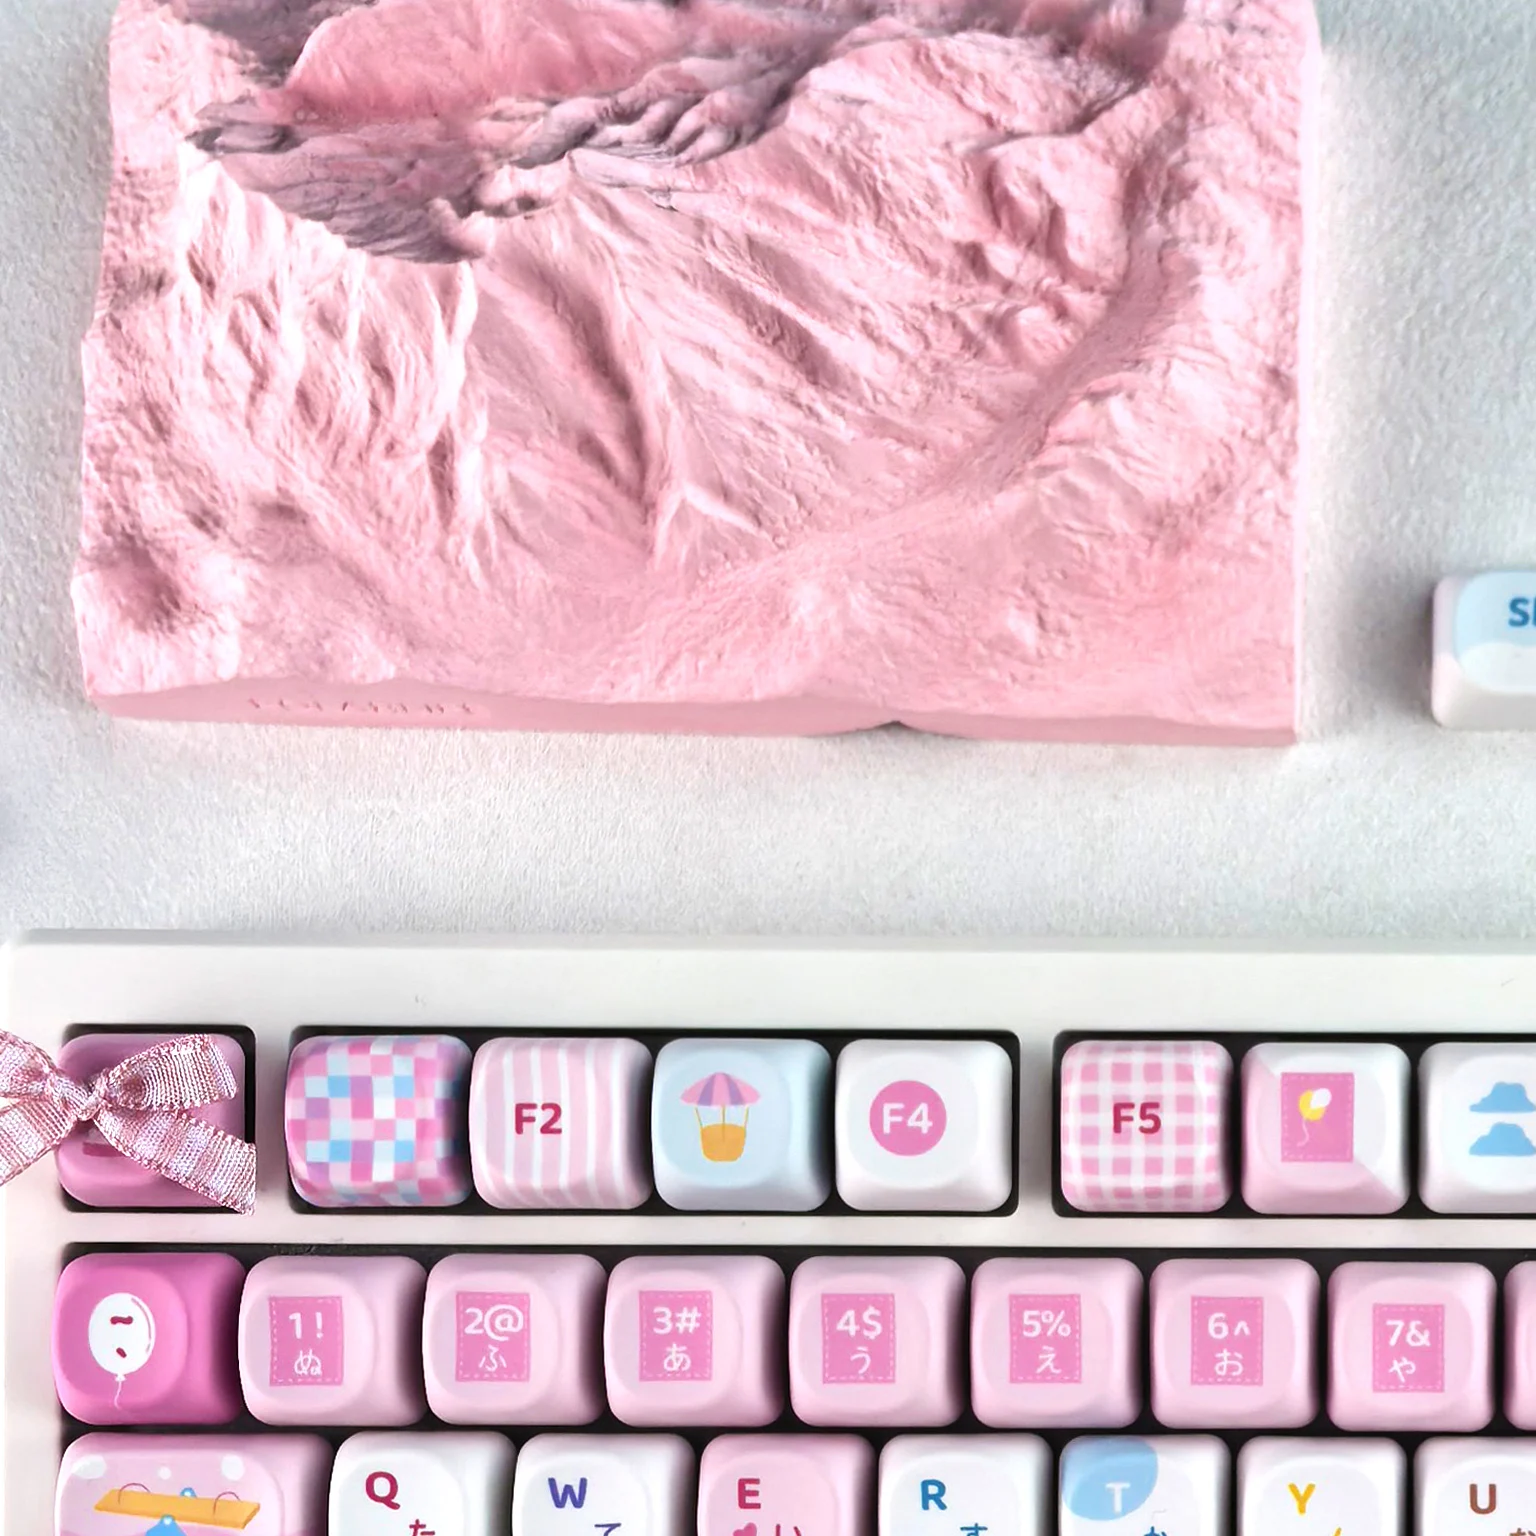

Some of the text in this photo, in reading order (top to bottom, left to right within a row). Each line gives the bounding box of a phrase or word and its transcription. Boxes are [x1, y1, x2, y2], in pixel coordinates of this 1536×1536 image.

[513, 1101, 564, 1137] F2
[881, 1102, 934, 1136] F4
[1111, 1100, 1163, 1136] F5
[288, 1311, 324, 1342] 1!
[463, 1305, 525, 1342] 2@
[652, 1305, 701, 1335] 3#
[835, 1305, 883, 1341] 4$
[1021, 1308, 1072, 1338] 5%
[1206, 1311, 1252, 1340] 6^
[1385, 1319, 1431, 1348] 7&
[293, 1348, 323, 1377] ぬ
[477, 1345, 509, 1373] ふ
[662, 1345, 692, 1374] あ
[850, 1346, 872, 1376] う
[1035, 1346, 1063, 1376] え
[1213, 1347, 1244, 1377] お
[1387, 1355, 1416, 1383] や
[364, 1470, 401, 1511] Q
[547, 1476, 589, 1510] W
[737, 1477, 763, 1510] E
[919, 1478, 949, 1512] R
[1104, 1481, 1131, 1514] T
[1286, 1482, 1317, 1516] Y
[1468, 1482, 1499, 1516] U
